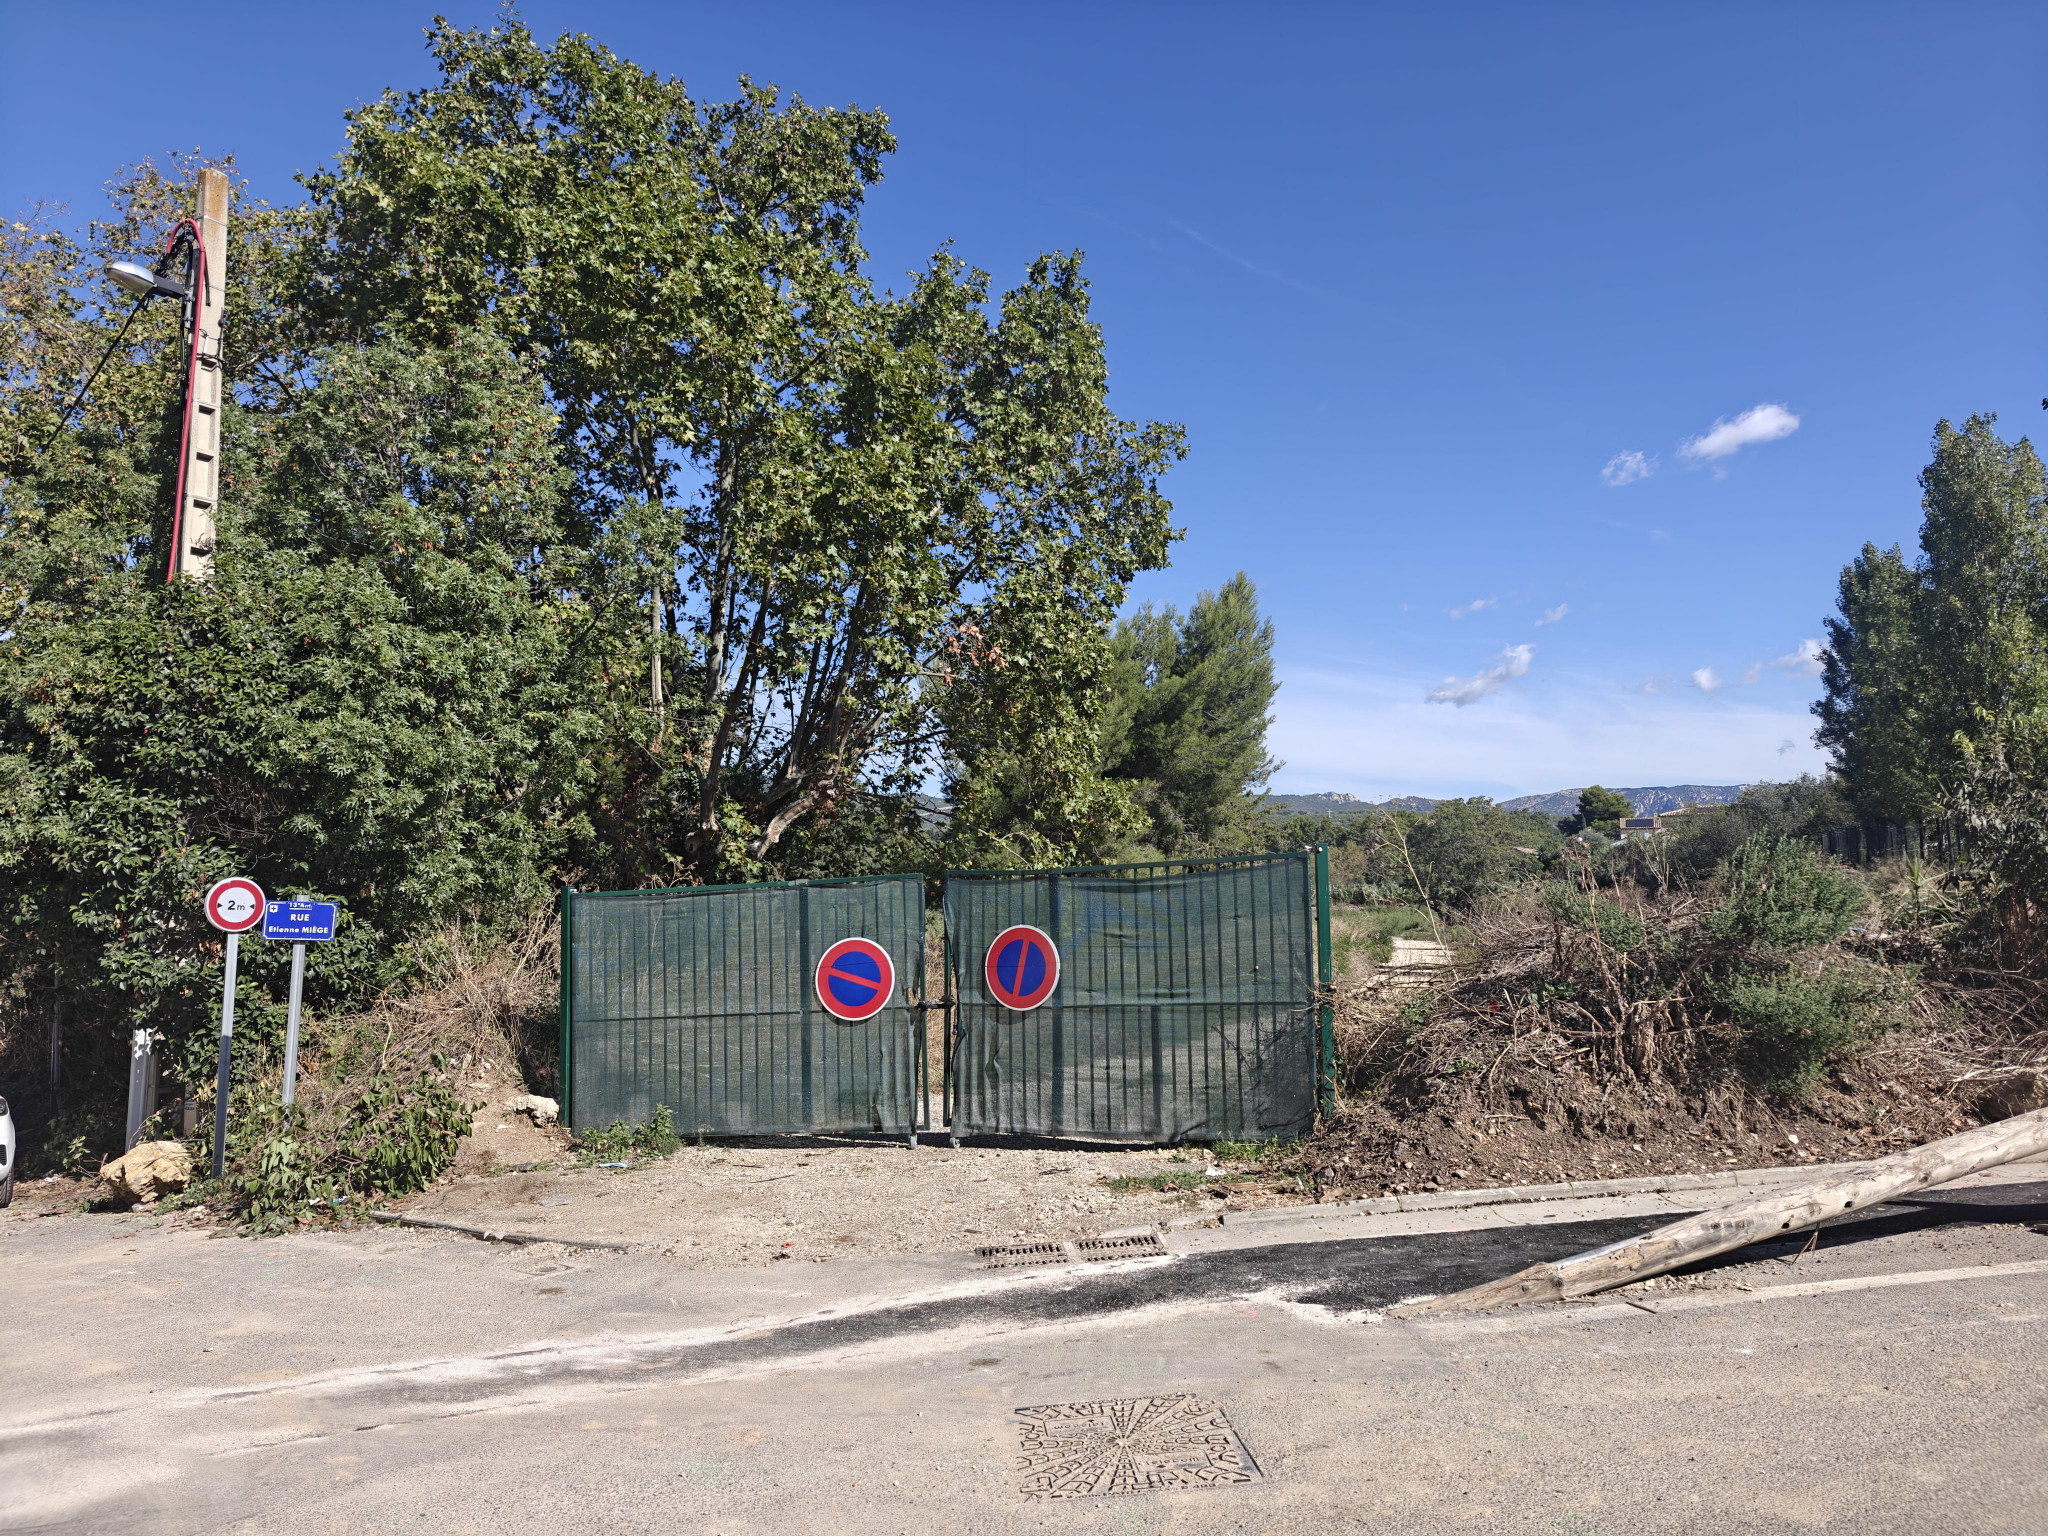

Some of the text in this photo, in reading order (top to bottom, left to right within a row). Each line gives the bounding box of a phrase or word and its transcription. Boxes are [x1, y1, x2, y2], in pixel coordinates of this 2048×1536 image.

[227, 900, 236, 911] 2
[290, 913, 310, 922] RUE
[301, 926, 329, 934] MIÈGE
